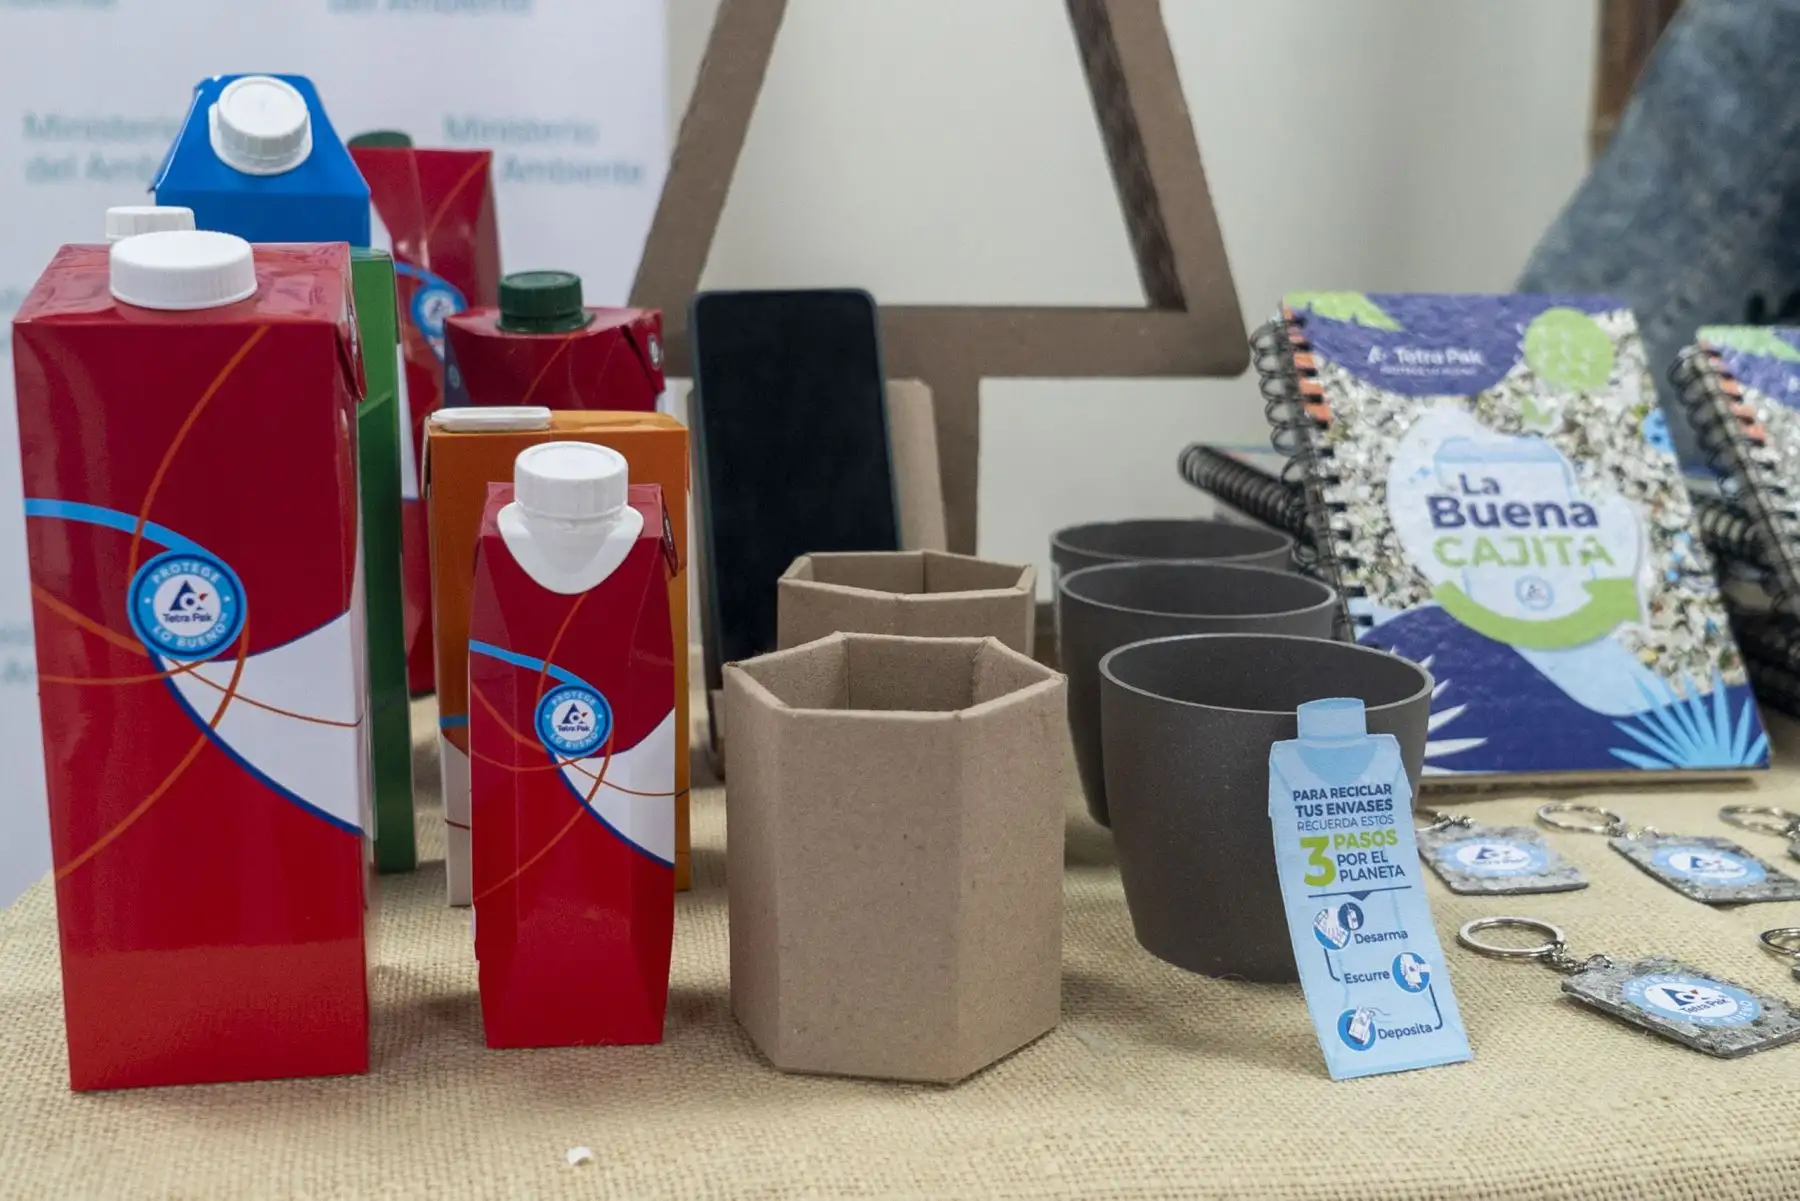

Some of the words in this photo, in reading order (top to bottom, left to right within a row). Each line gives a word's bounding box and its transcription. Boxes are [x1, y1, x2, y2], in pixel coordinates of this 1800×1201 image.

[1392, 345, 1444, 365] Tetra
[1458, 472, 1501, 495] La
[1426, 494, 1599, 529] Buena
[1432, 534, 1616, 568] CAJITA
[163, 613, 190, 622] Tetra
[192, 613, 212, 622] Pak
[1293, 788, 1328, 801] PARA
[1330, 783, 1393, 798] RECICLAR
[1295, 804, 1323, 818] TUS
[1326, 798, 1394, 815] ENVASES
[1297, 818, 1359, 832] RECUERDA
[1361, 814, 1395, 827] ESTOS
[1300, 836, 1337, 887] 3
[1333, 828, 1399, 850] PASOS
[1337, 852, 1368, 866] POR
[1371, 850, 1389, 863] EL
[1339, 864, 1406, 882] PLANETA
[1354, 930, 1409, 944] Desarma
[1344, 970, 1391, 984] Escurre
[1377, 1022, 1433, 1040] Deposita
